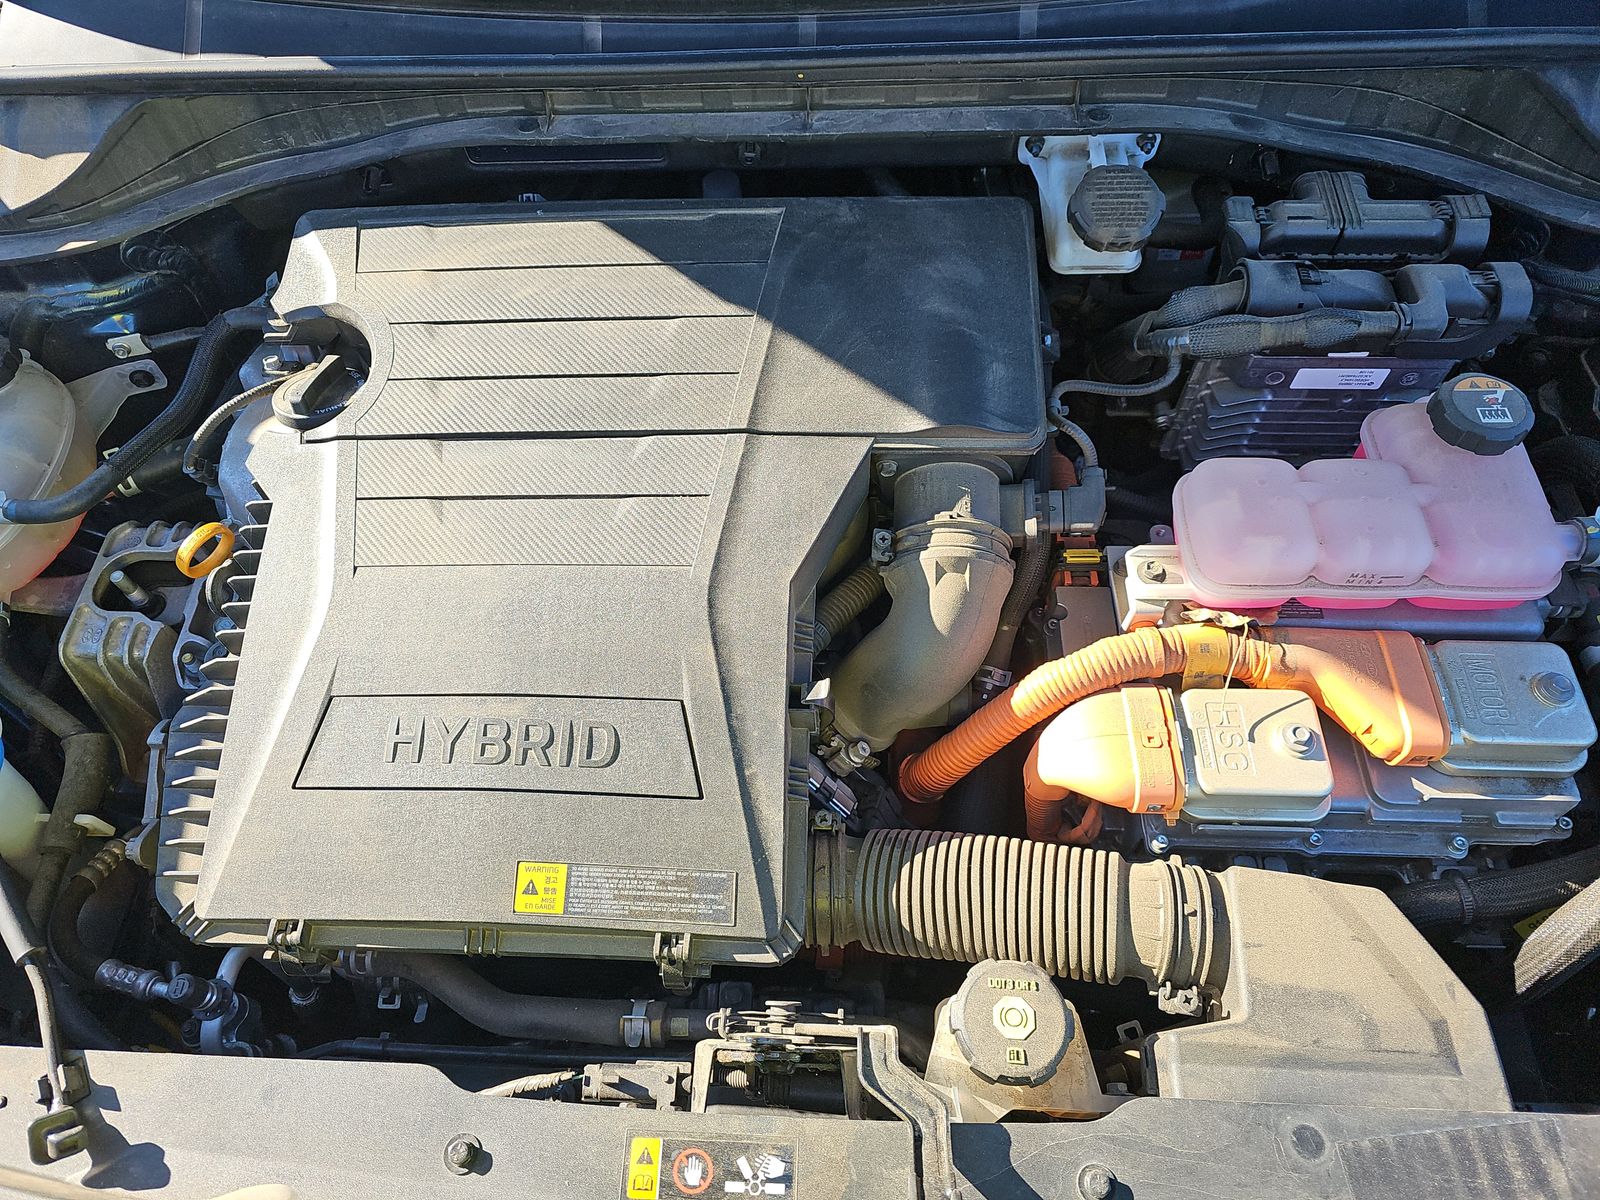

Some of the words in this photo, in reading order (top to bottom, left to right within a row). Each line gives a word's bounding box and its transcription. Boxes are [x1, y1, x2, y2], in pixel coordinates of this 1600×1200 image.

[1465, 658, 1510, 720] MOTOR
[384, 715, 621, 769] HYBRID
[1212, 708, 1249, 771] HSG
[525, 865, 560, 873] WARNING
[535, 903, 556, 911] GARDE
